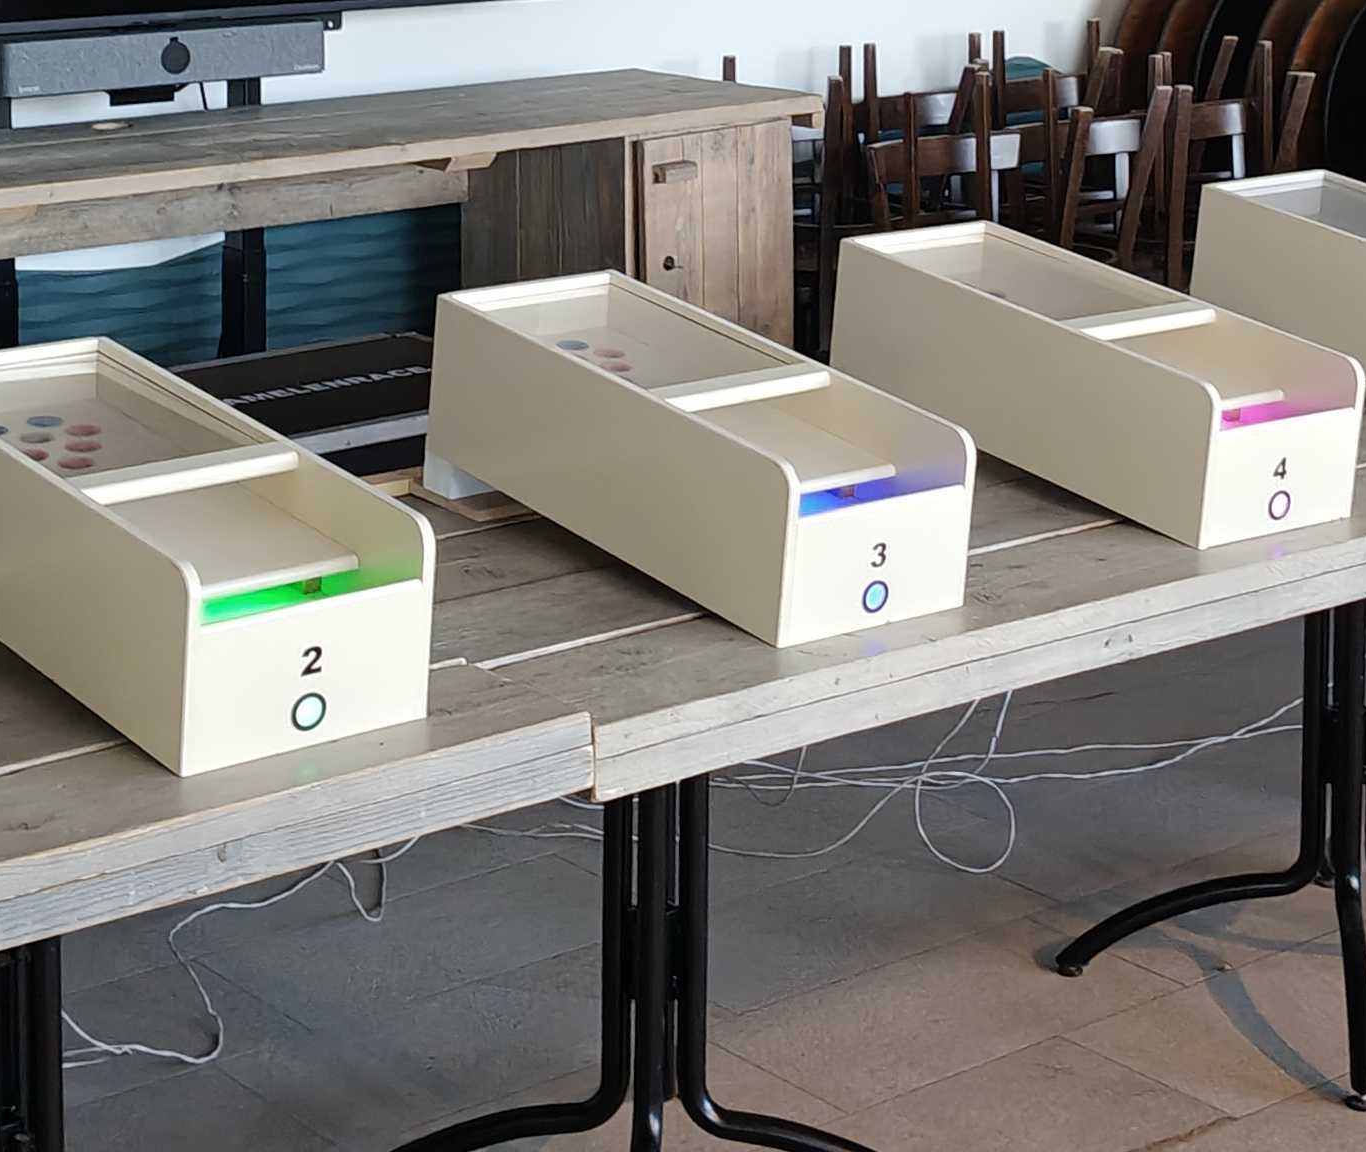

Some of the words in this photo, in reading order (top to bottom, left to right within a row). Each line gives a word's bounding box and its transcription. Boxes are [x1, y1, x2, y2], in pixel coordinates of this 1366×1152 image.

[1273, 457, 1287, 480] 4
[870, 542, 887, 568] 3
[301, 646, 323, 677] 2
